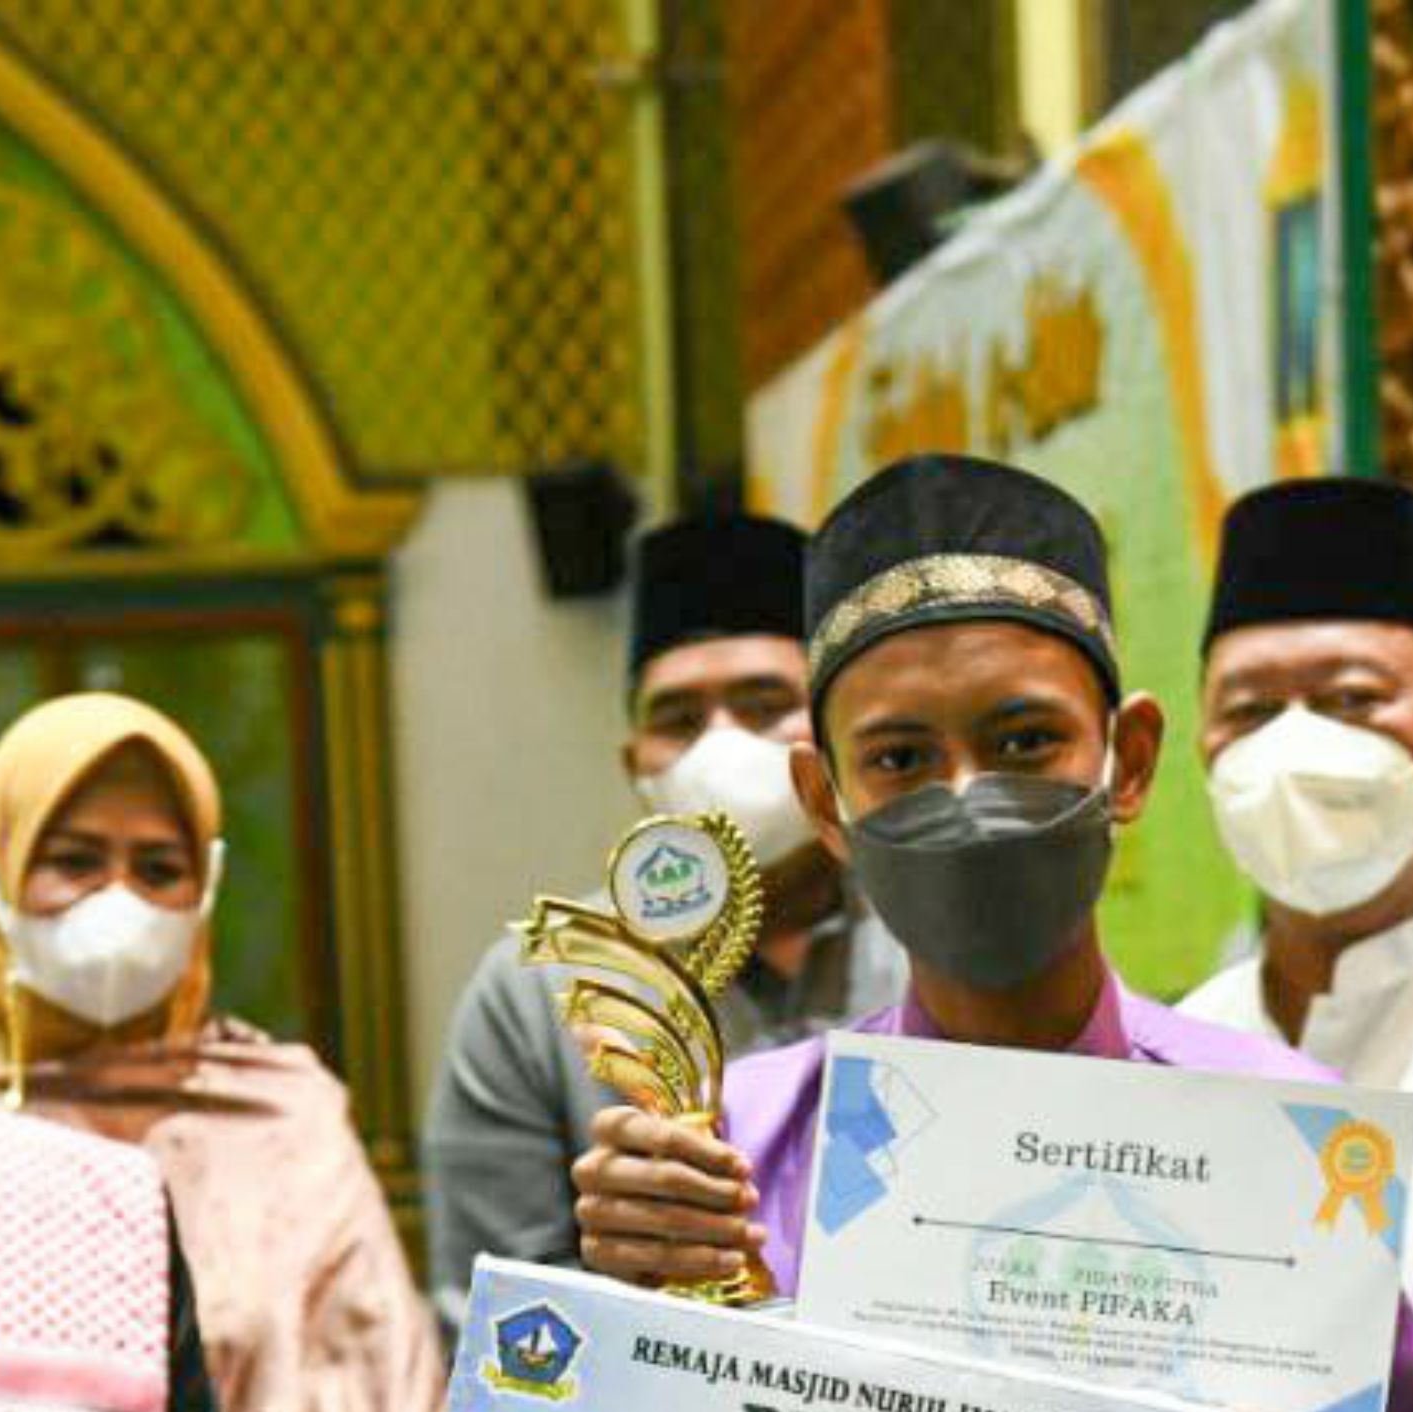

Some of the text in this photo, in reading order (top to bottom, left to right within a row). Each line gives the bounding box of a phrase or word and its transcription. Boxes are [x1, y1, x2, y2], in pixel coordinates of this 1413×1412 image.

[1013, 1130, 1211, 1183] Sertifikat
[987, 1279, 1196, 1326] Event PIFAKA
[631, 1336, 741, 1385] REMAJA
[748, 1359, 851, 1404] MASJID
